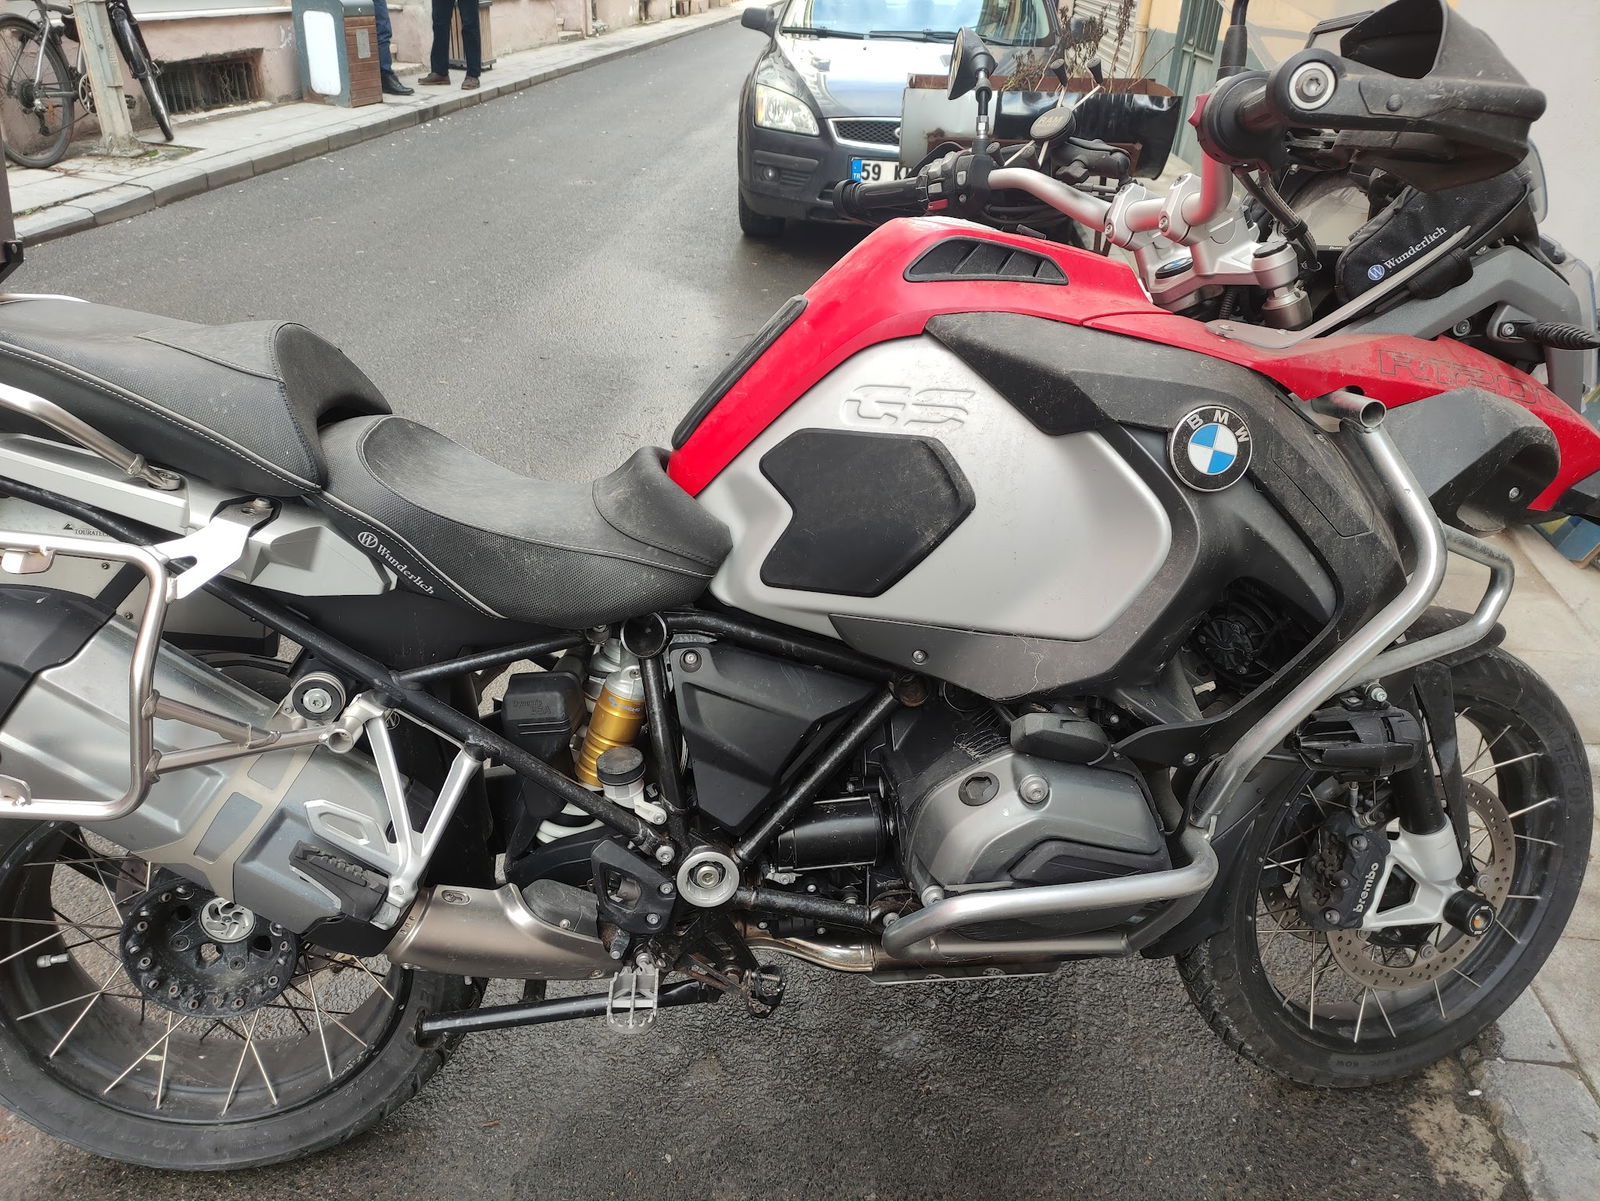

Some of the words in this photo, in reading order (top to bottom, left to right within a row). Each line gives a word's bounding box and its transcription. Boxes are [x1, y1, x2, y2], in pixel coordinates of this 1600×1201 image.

[861, 163, 882, 181] 59
[1383, 226, 1448, 269] Wunderlich
[839, 384, 976, 428] GS
[1186, 409, 1250, 443] BMW
[377, 543, 435, 595] Wunderlich
[1353, 862, 1379, 913] brembo
